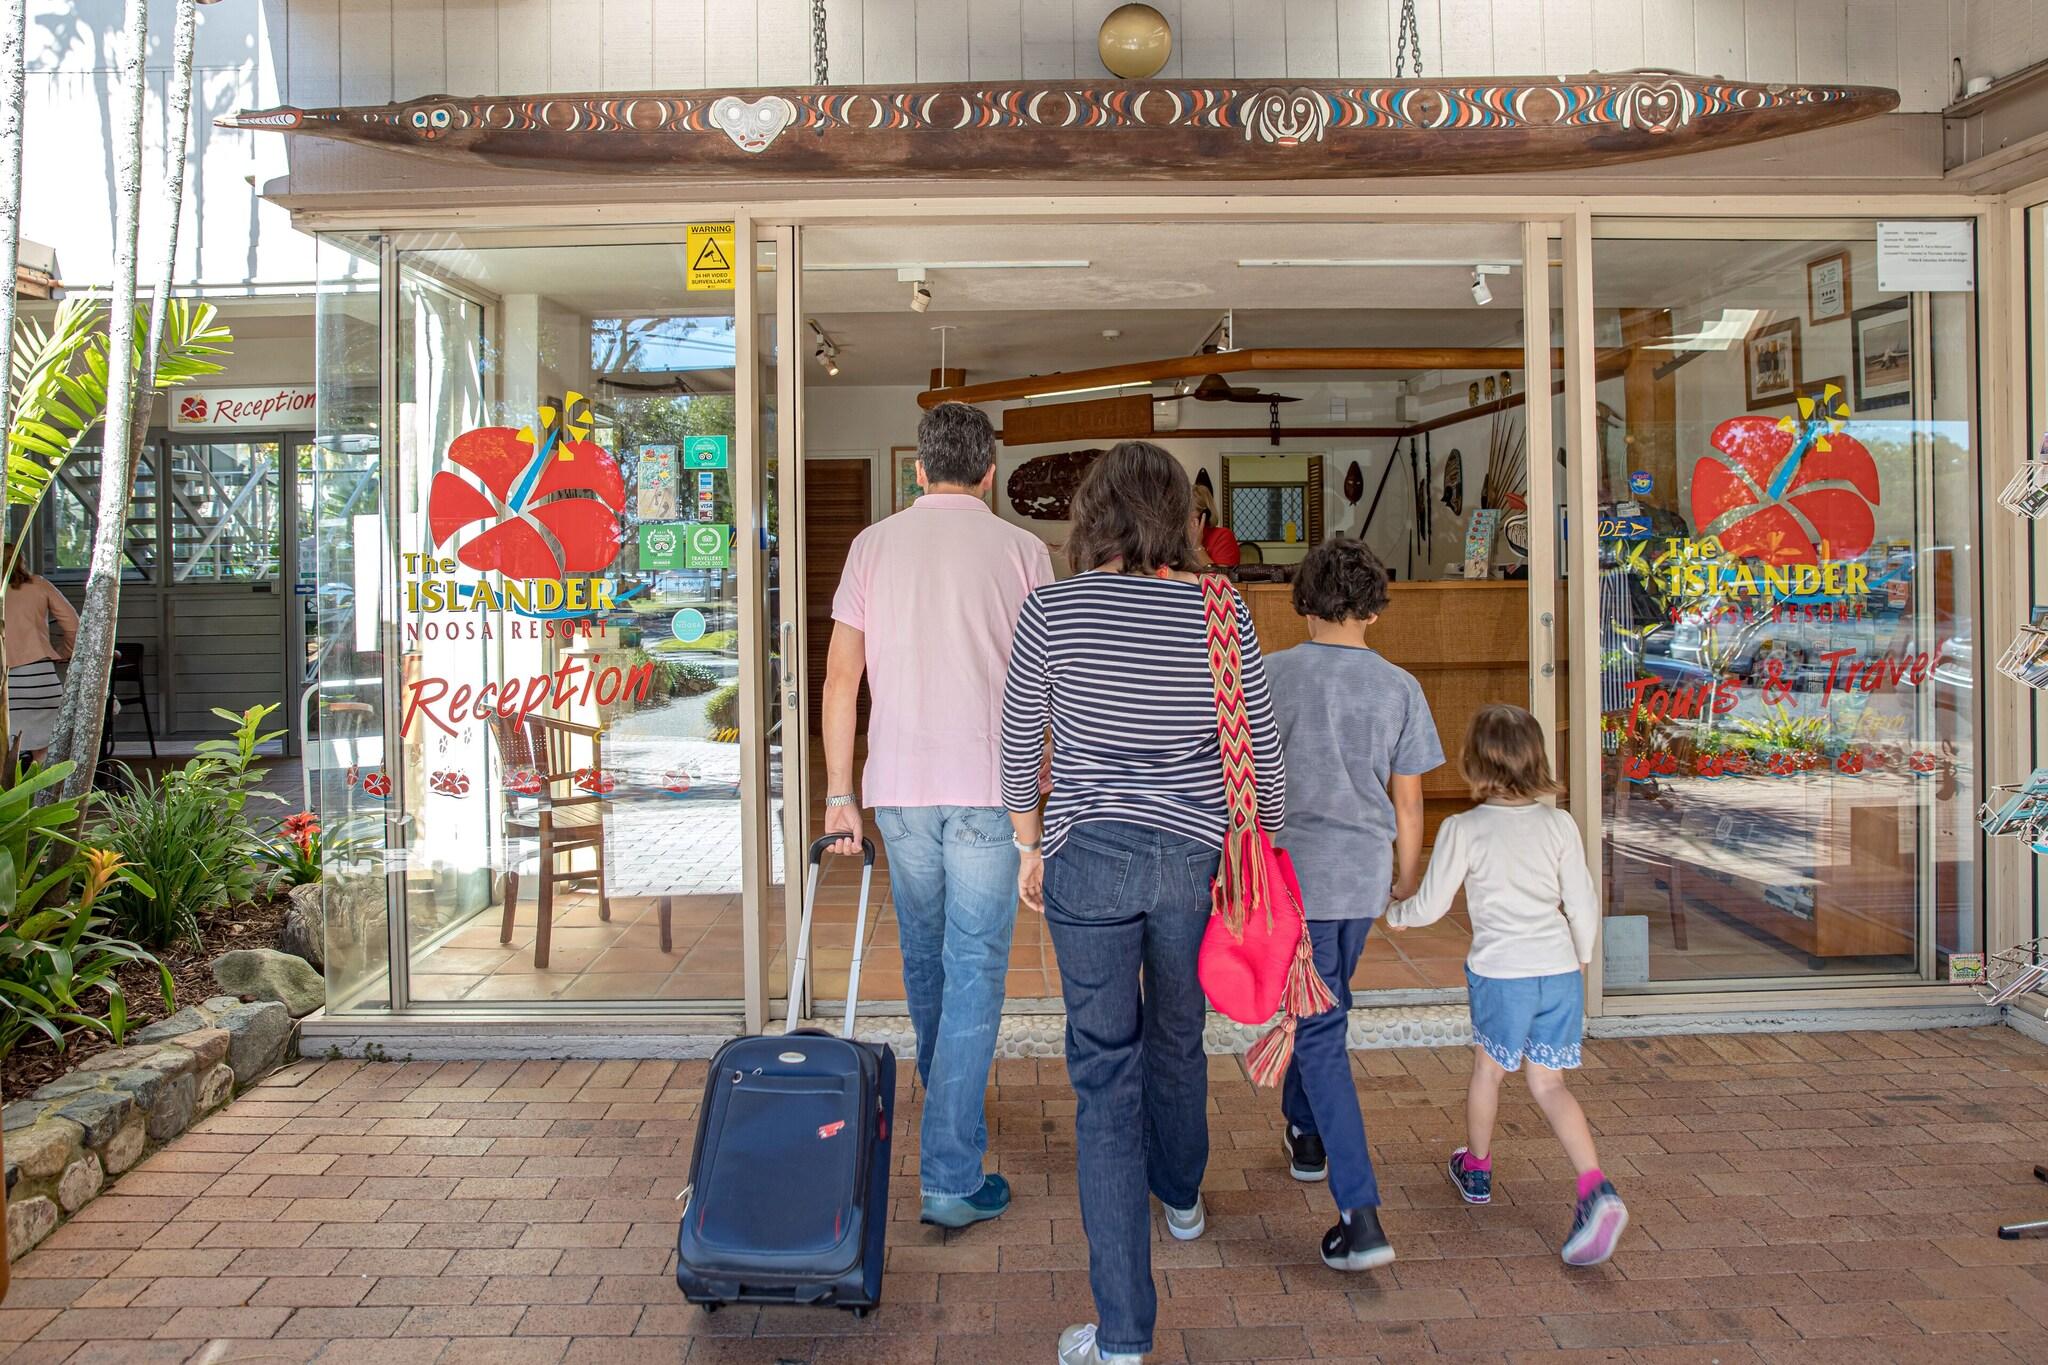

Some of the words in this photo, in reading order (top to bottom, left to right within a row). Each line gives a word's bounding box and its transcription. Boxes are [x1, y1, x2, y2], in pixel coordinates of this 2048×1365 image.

[691, 225, 732, 233] WARNING
[213, 390, 317, 423] Reception
[1665, 537, 1716, 558] The
[403, 553, 457, 574] The
[1668, 563, 1872, 598] ISLANDER
[406, 577, 619, 613] ISLANDER
[1670, 604, 1755, 625] NOOSA
[1772, 604, 1864, 624] RESORT
[407, 621, 493, 641] NOOSA
[511, 619, 608, 639] RESORT
[400, 654, 655, 738] Reception
[1624, 675, 1744, 738] Tours
[1761, 658, 1798, 707] &
[1820, 636, 1944, 709] Travel
